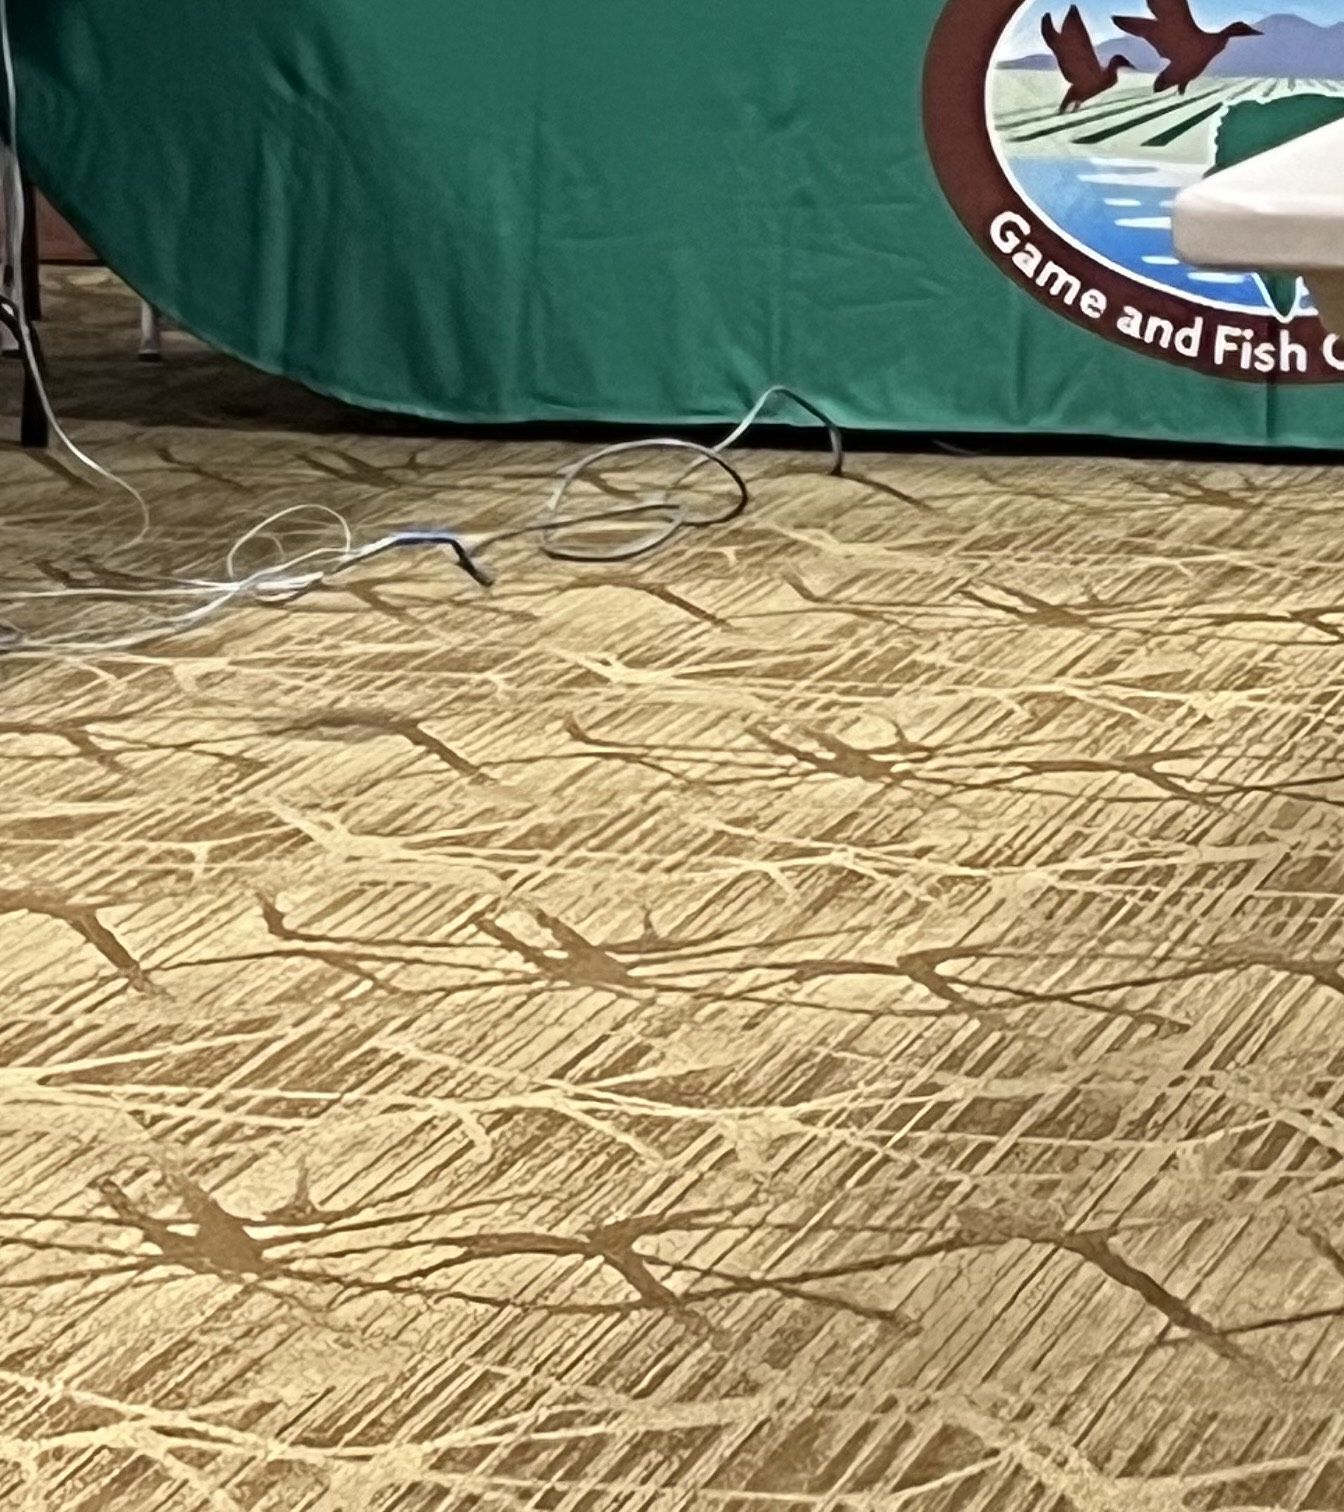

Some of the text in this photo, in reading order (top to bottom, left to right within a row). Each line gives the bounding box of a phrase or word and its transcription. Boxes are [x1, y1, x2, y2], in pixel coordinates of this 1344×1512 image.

[989, 210, 1107, 319] Game
[1116, 305, 1204, 357] and
[1213, 324, 1308, 373] Fish
